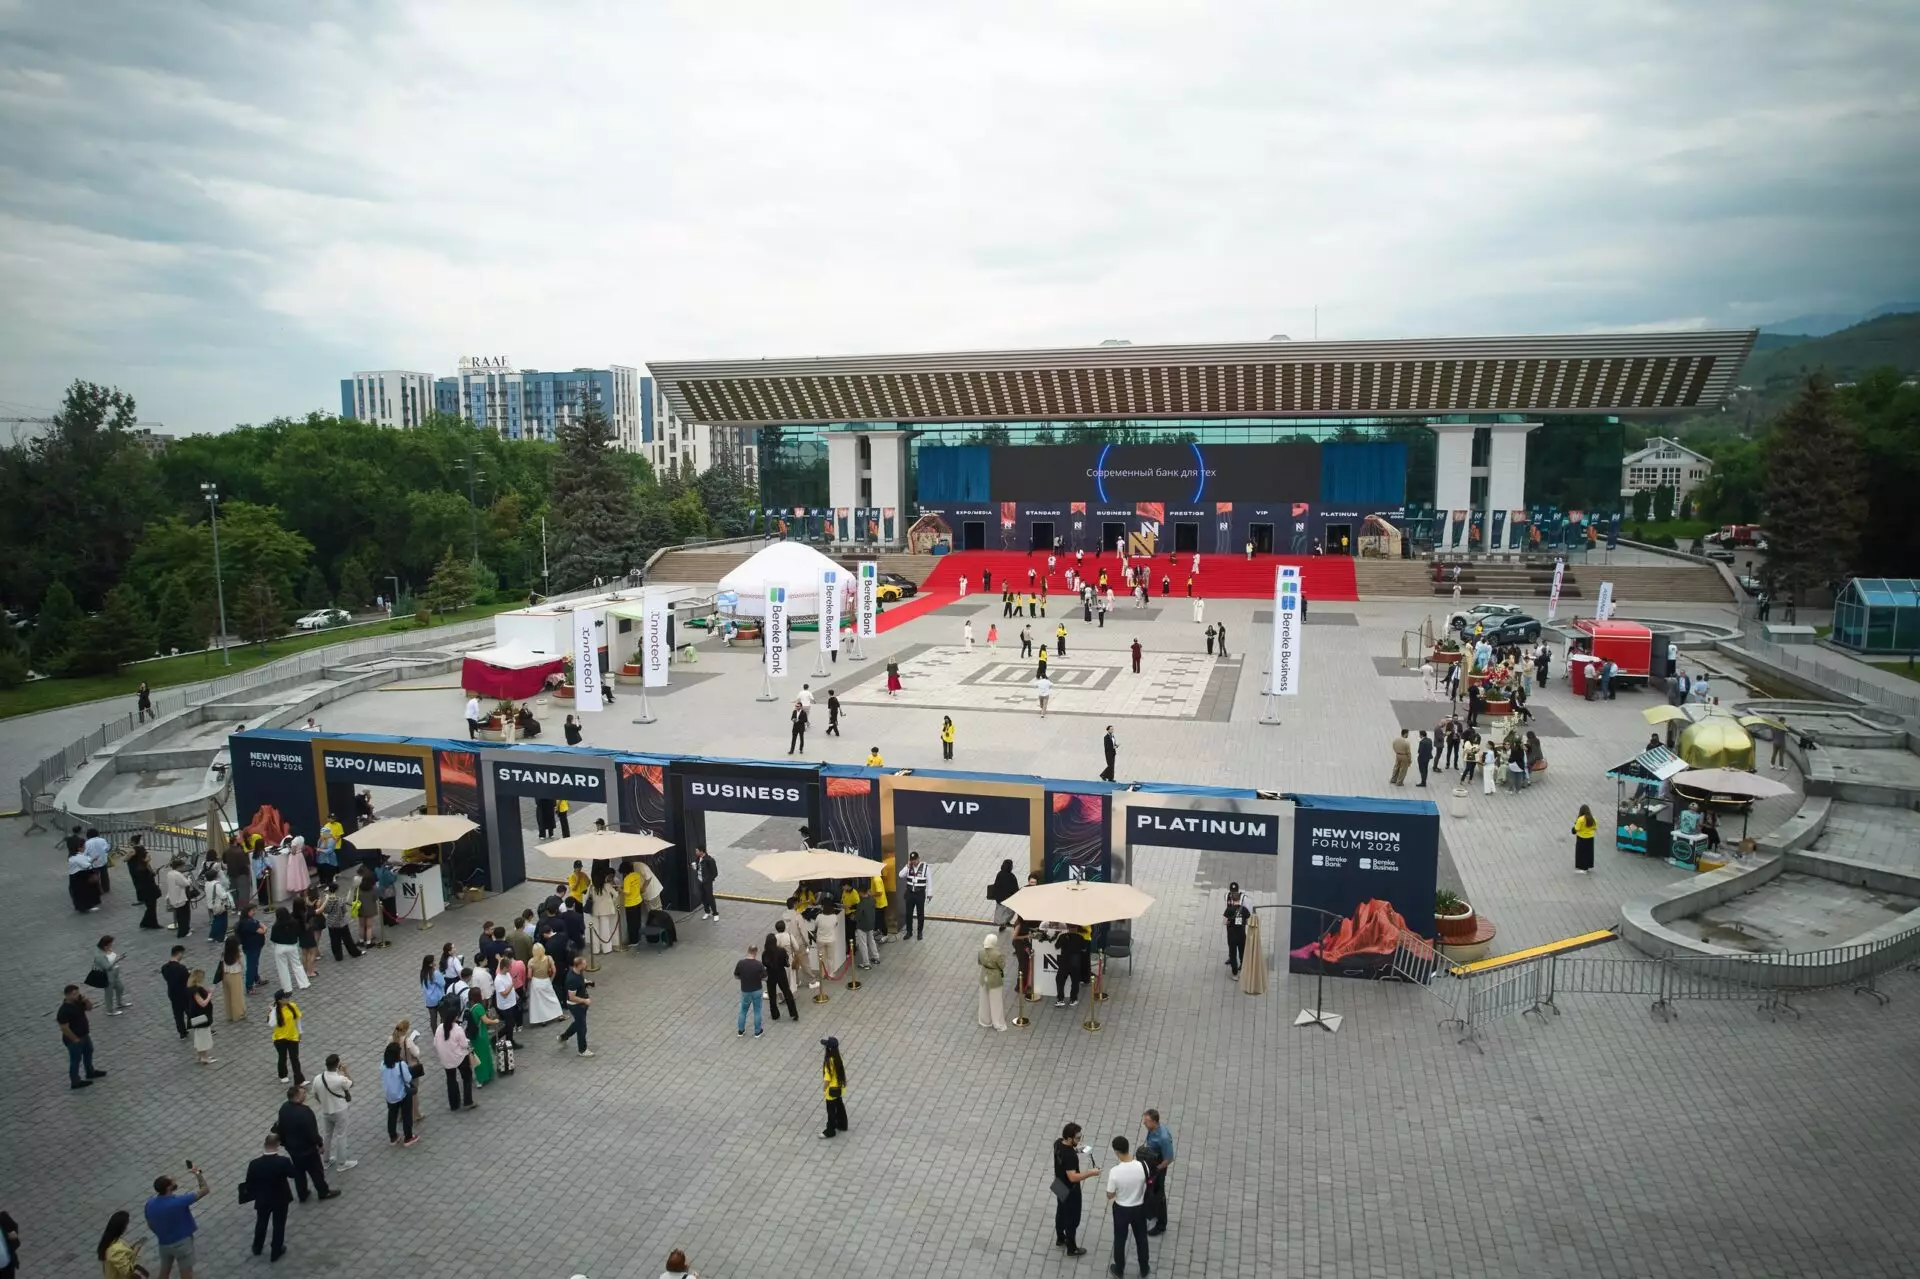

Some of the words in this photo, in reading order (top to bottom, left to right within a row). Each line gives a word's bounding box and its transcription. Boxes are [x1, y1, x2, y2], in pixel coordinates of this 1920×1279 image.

[1086, 467, 1154, 479] Современный
[1156, 467, 1179, 477] банк
[1181, 468, 1198, 478] для
[1200, 468, 1217, 477] тех
[825, 585, 834, 614] Bereke
[863, 579, 873, 611] Bereke
[771, 605, 782, 643] Bereke
[825, 615, 834, 649] Business
[863, 612, 873, 636] Bank
[1281, 612, 1292, 649] Bereke
[771, 645, 783, 674] Bank
[1280, 651, 1291, 691] Business
[250, 752, 273, 761] NEW
[273, 753, 302, 763] VISION
[250, 760, 281, 769] FORUM
[283, 761, 303, 771] 2026
[325, 756, 423, 776] EXPO/MEDIA
[499, 768, 600, 788] STANDARD
[692, 782, 800, 802] BUSINESS
[940, 800, 980, 815] VIP
[1137, 815, 1267, 837] PLATINUM
[1312, 827, 1348, 838] NEW
[1350, 829, 1401, 842] VISION
[1312, 838, 1361, 850] FORUM
[1368, 841, 1401, 853] 2026
[1324, 855, 1348, 864] Bereke
[1324, 860, 1342, 868] Bank
[1372, 858, 1396, 866] Bereke
[1372, 863, 1399, 872] Business
